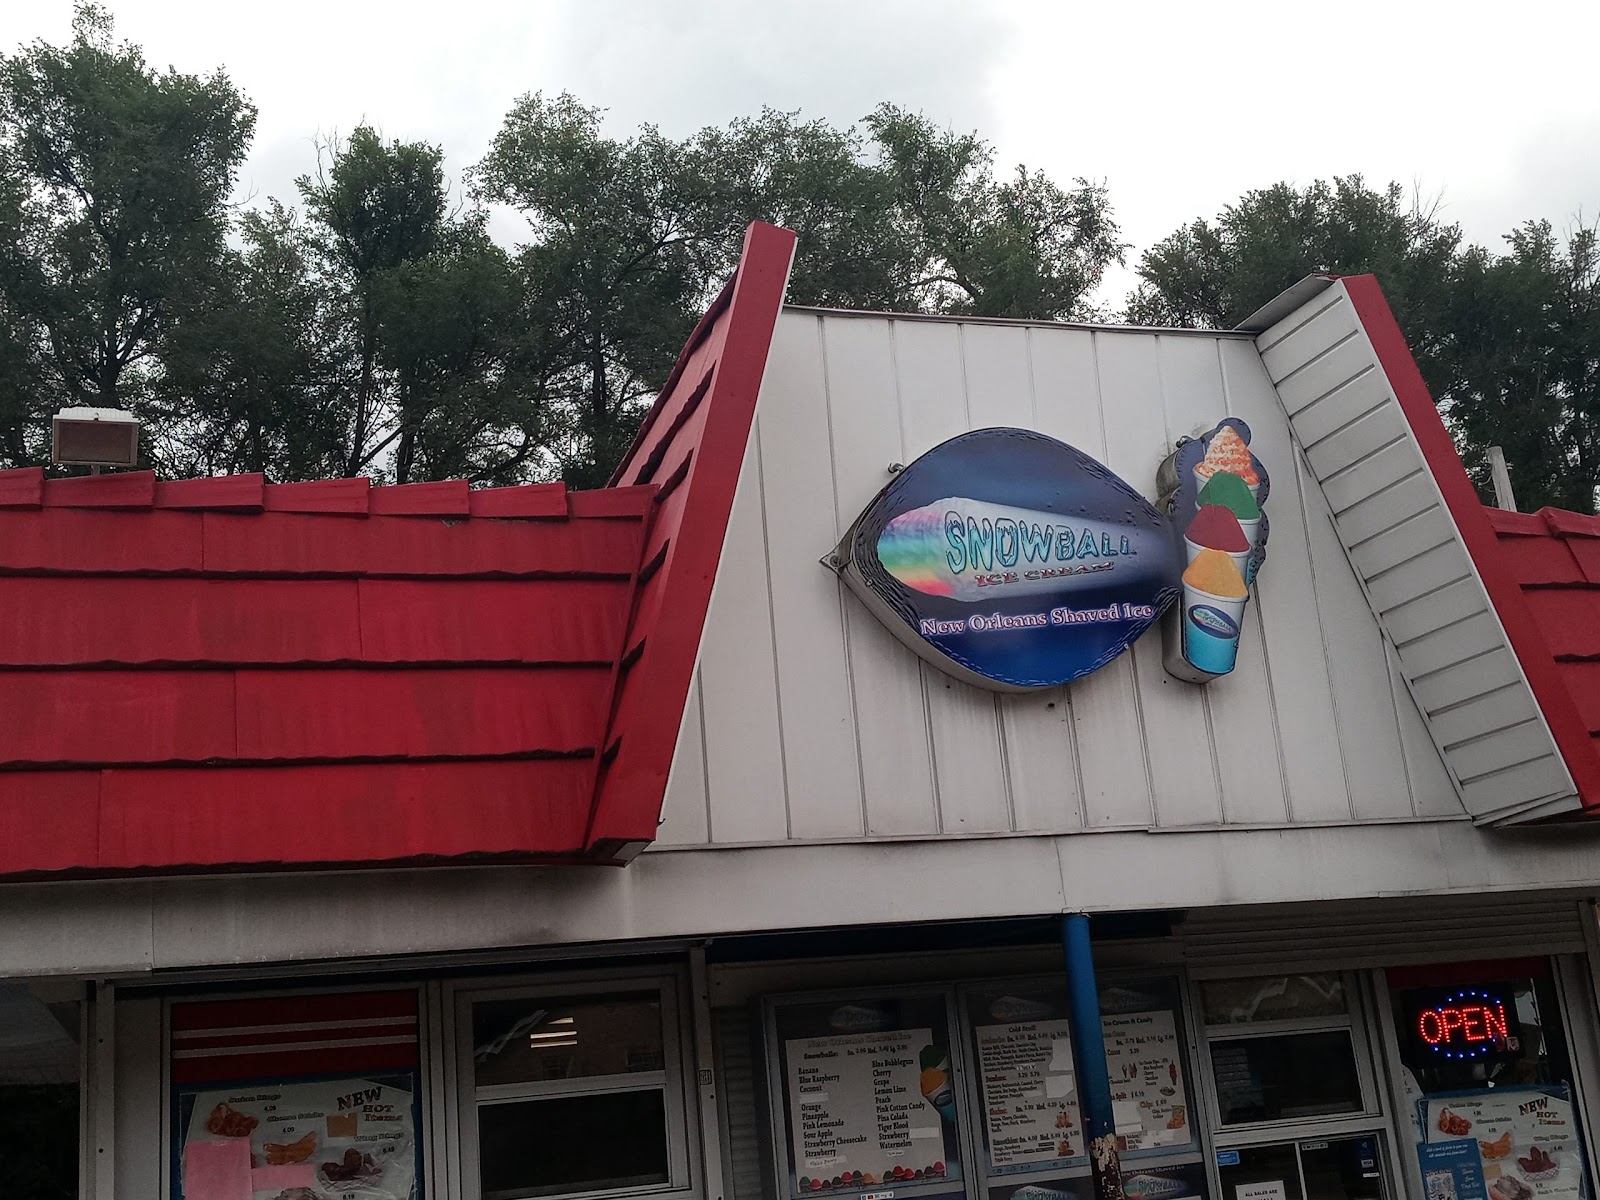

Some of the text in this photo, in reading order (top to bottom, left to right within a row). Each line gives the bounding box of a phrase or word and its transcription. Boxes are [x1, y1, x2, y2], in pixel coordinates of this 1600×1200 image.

[944, 510, 1137, 575] SNOWBALL
[974, 561, 1114, 587] ICE CREAM
[920, 602, 1153, 636] New Orleans Shaved Ice
[1419, 1004, 1509, 1044] OPEN
[872, 1058, 914, 1068] Blue Bubblegum
[798, 1067, 819, 1075] Banana
[872, 1069, 891, 1078] Cherry
[799, 1074, 840, 1085] Blue Raspberry
[873, 1078, 890, 1087] Grape
[799, 1085, 823, 1093] Coconut
[874, 1087, 892, 1095] Lemon
[229, 1086, 383, 1112] Onion Rings NEW
[875, 1096, 891, 1104] Peach
[362, 1104, 394, 1112] HOT
[801, 1104, 821, 1113] Orange
[876, 1102, 926, 1114] Pink Cotton Candy
[1518, 1096, 1549, 1116] NEW
[267, 1111, 404, 1123] Cheese Sticks Items
[802, 1112, 829, 1122] Pineapple
[877, 1112, 909, 1122] Pina Colada
[1536, 1111, 1559, 1119] HOT
[802, 1119, 845, 1130] Pink Lemonade
[877, 1121, 909, 1133] Tiger Blood
[1538, 1118, 1566, 1126] Items
[354, 1134, 378, 1142] Wing
[803, 1129, 834, 1140] Sour Apple
[878, 1131, 909, 1141] Strawberry
[804, 1135, 868, 1149] Strawberry Cheesecake
[879, 1140, 913, 1150] Watermelon
[805, 1148, 837, 1159] Strawberry
